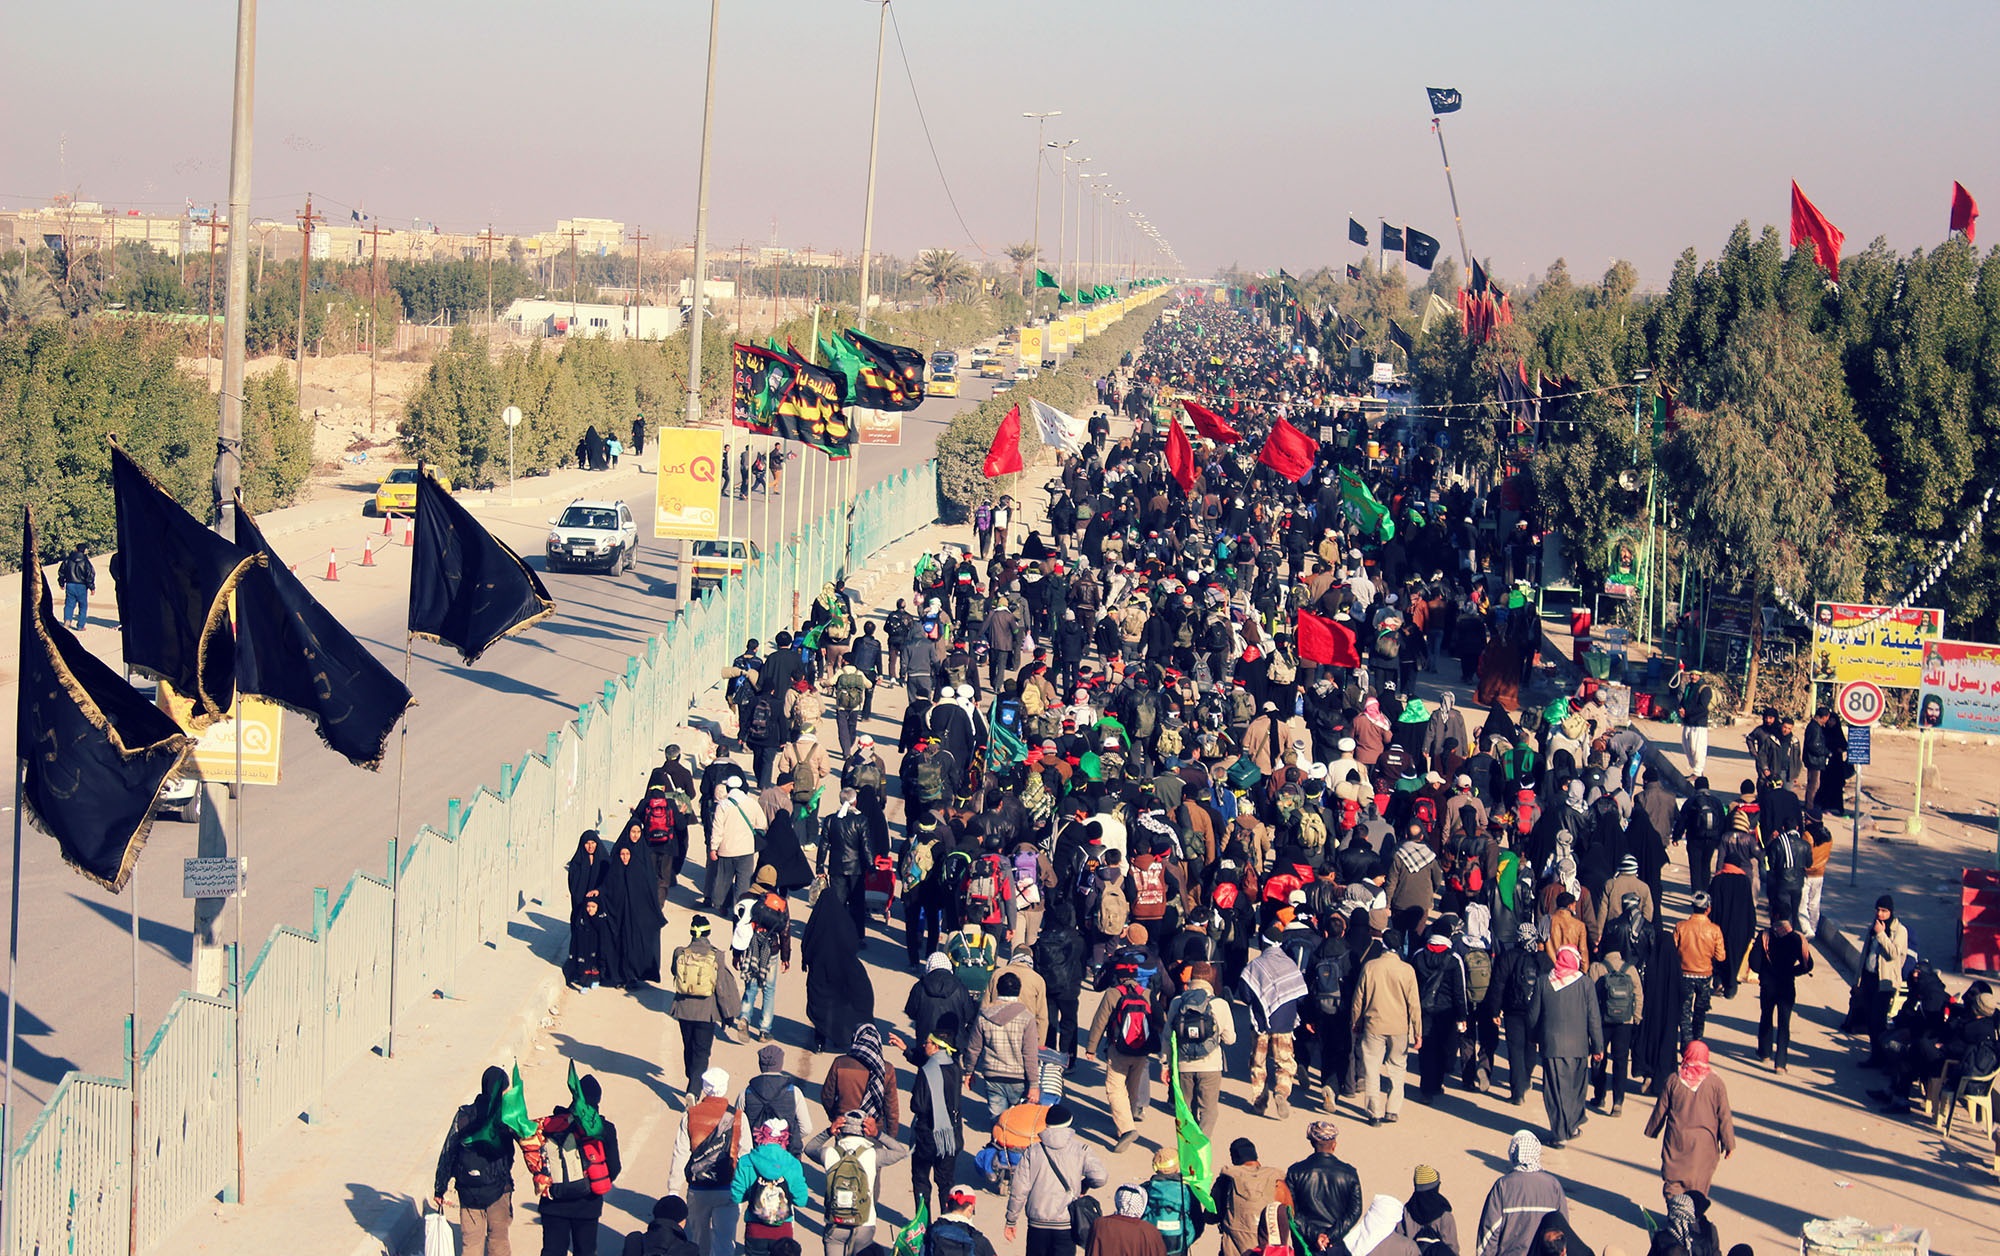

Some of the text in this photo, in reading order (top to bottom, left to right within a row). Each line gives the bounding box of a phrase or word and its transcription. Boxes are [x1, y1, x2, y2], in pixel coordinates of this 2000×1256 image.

[663, 456, 715, 482] Q كي
[1881, 628, 1923, 655] فينة
[1924, 668, 1946, 687] الله
[1948, 672, 1987, 695] رسول
[1848, 691, 1875, 714] 80
[243, 725, 267, 751] Q
